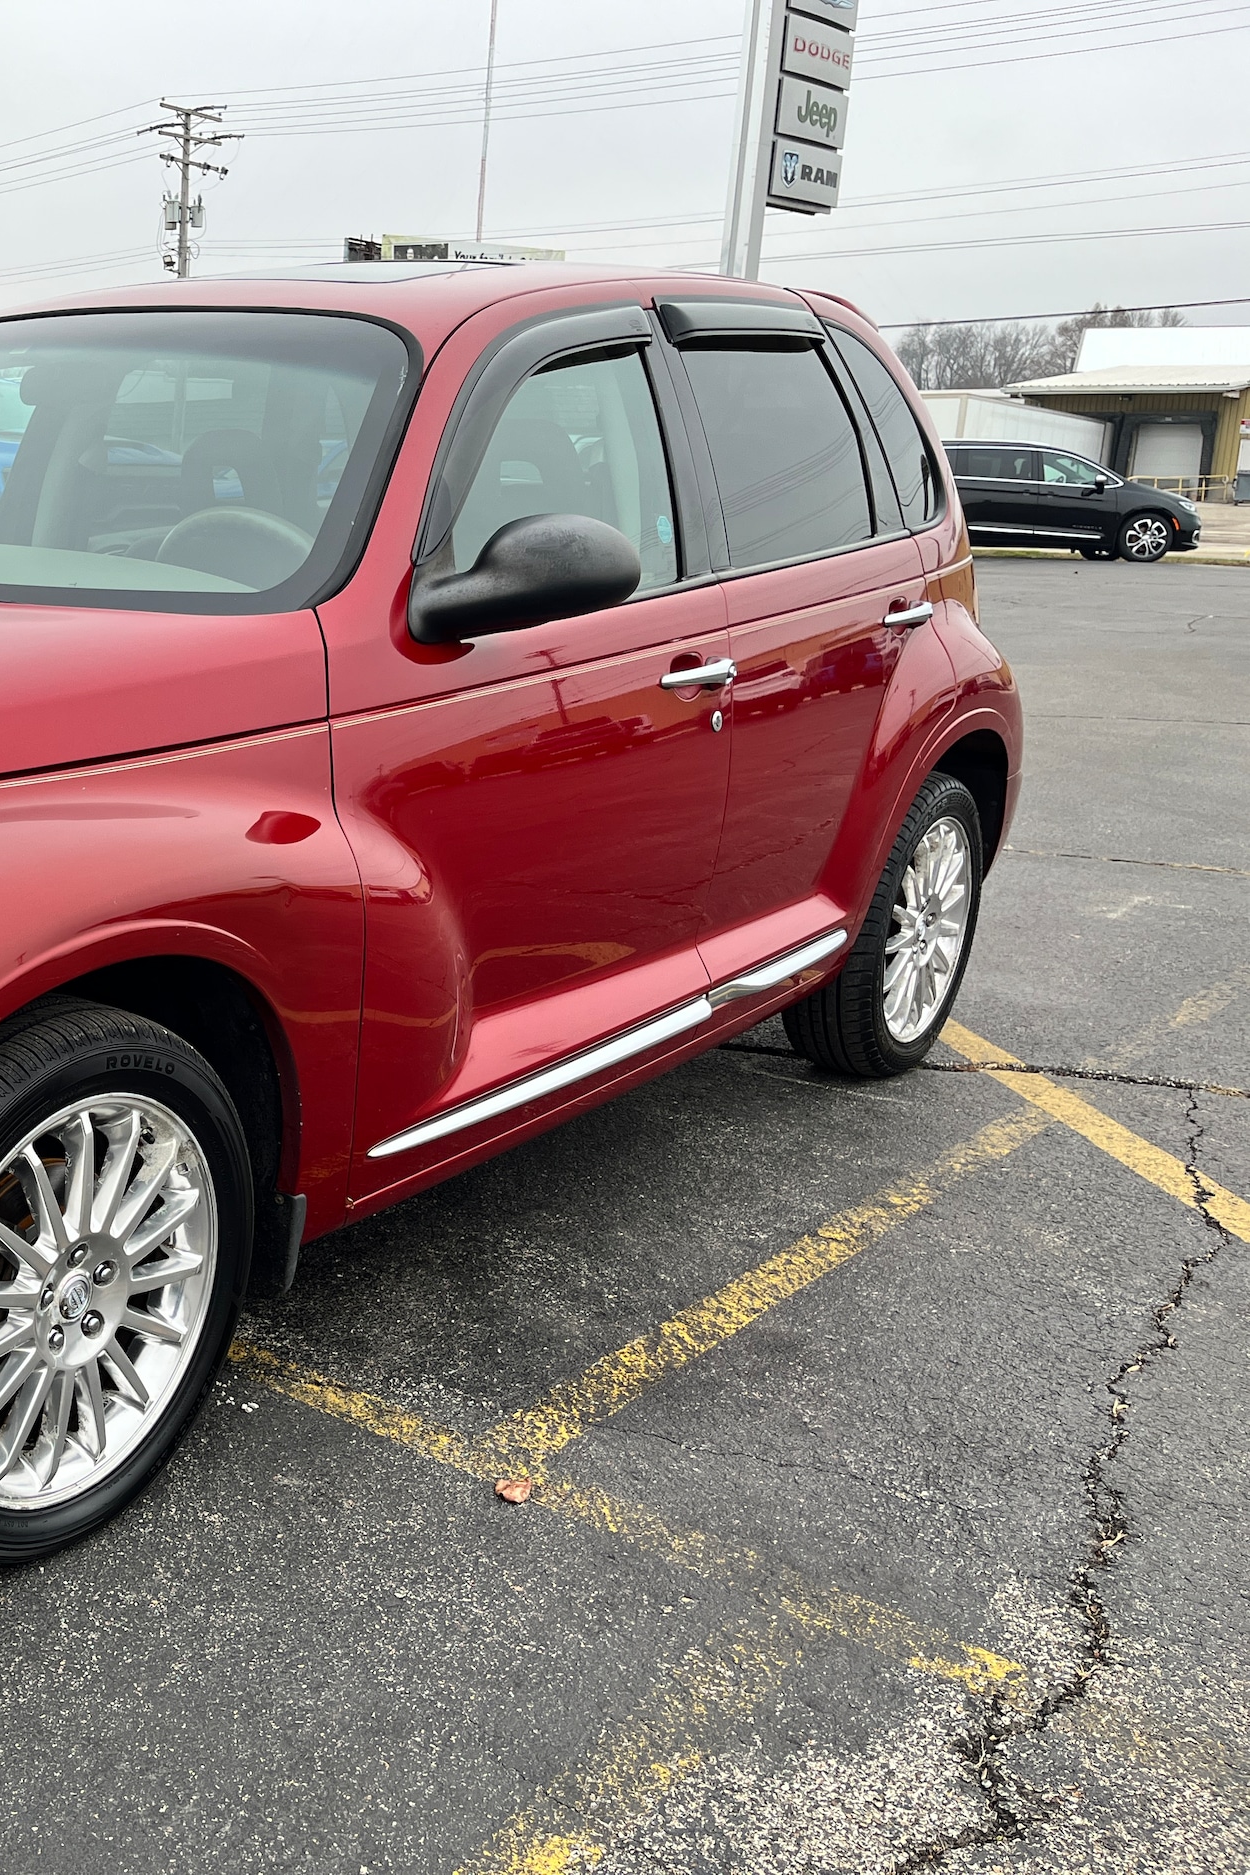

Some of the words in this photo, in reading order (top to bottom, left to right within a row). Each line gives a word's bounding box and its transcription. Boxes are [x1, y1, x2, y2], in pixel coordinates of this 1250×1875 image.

[793, 36, 850, 70] DODGE
[797, 89, 838, 138] Jeep
[800, 164, 838, 188] RAM
[105, 1054, 175, 1075] ROVELO
